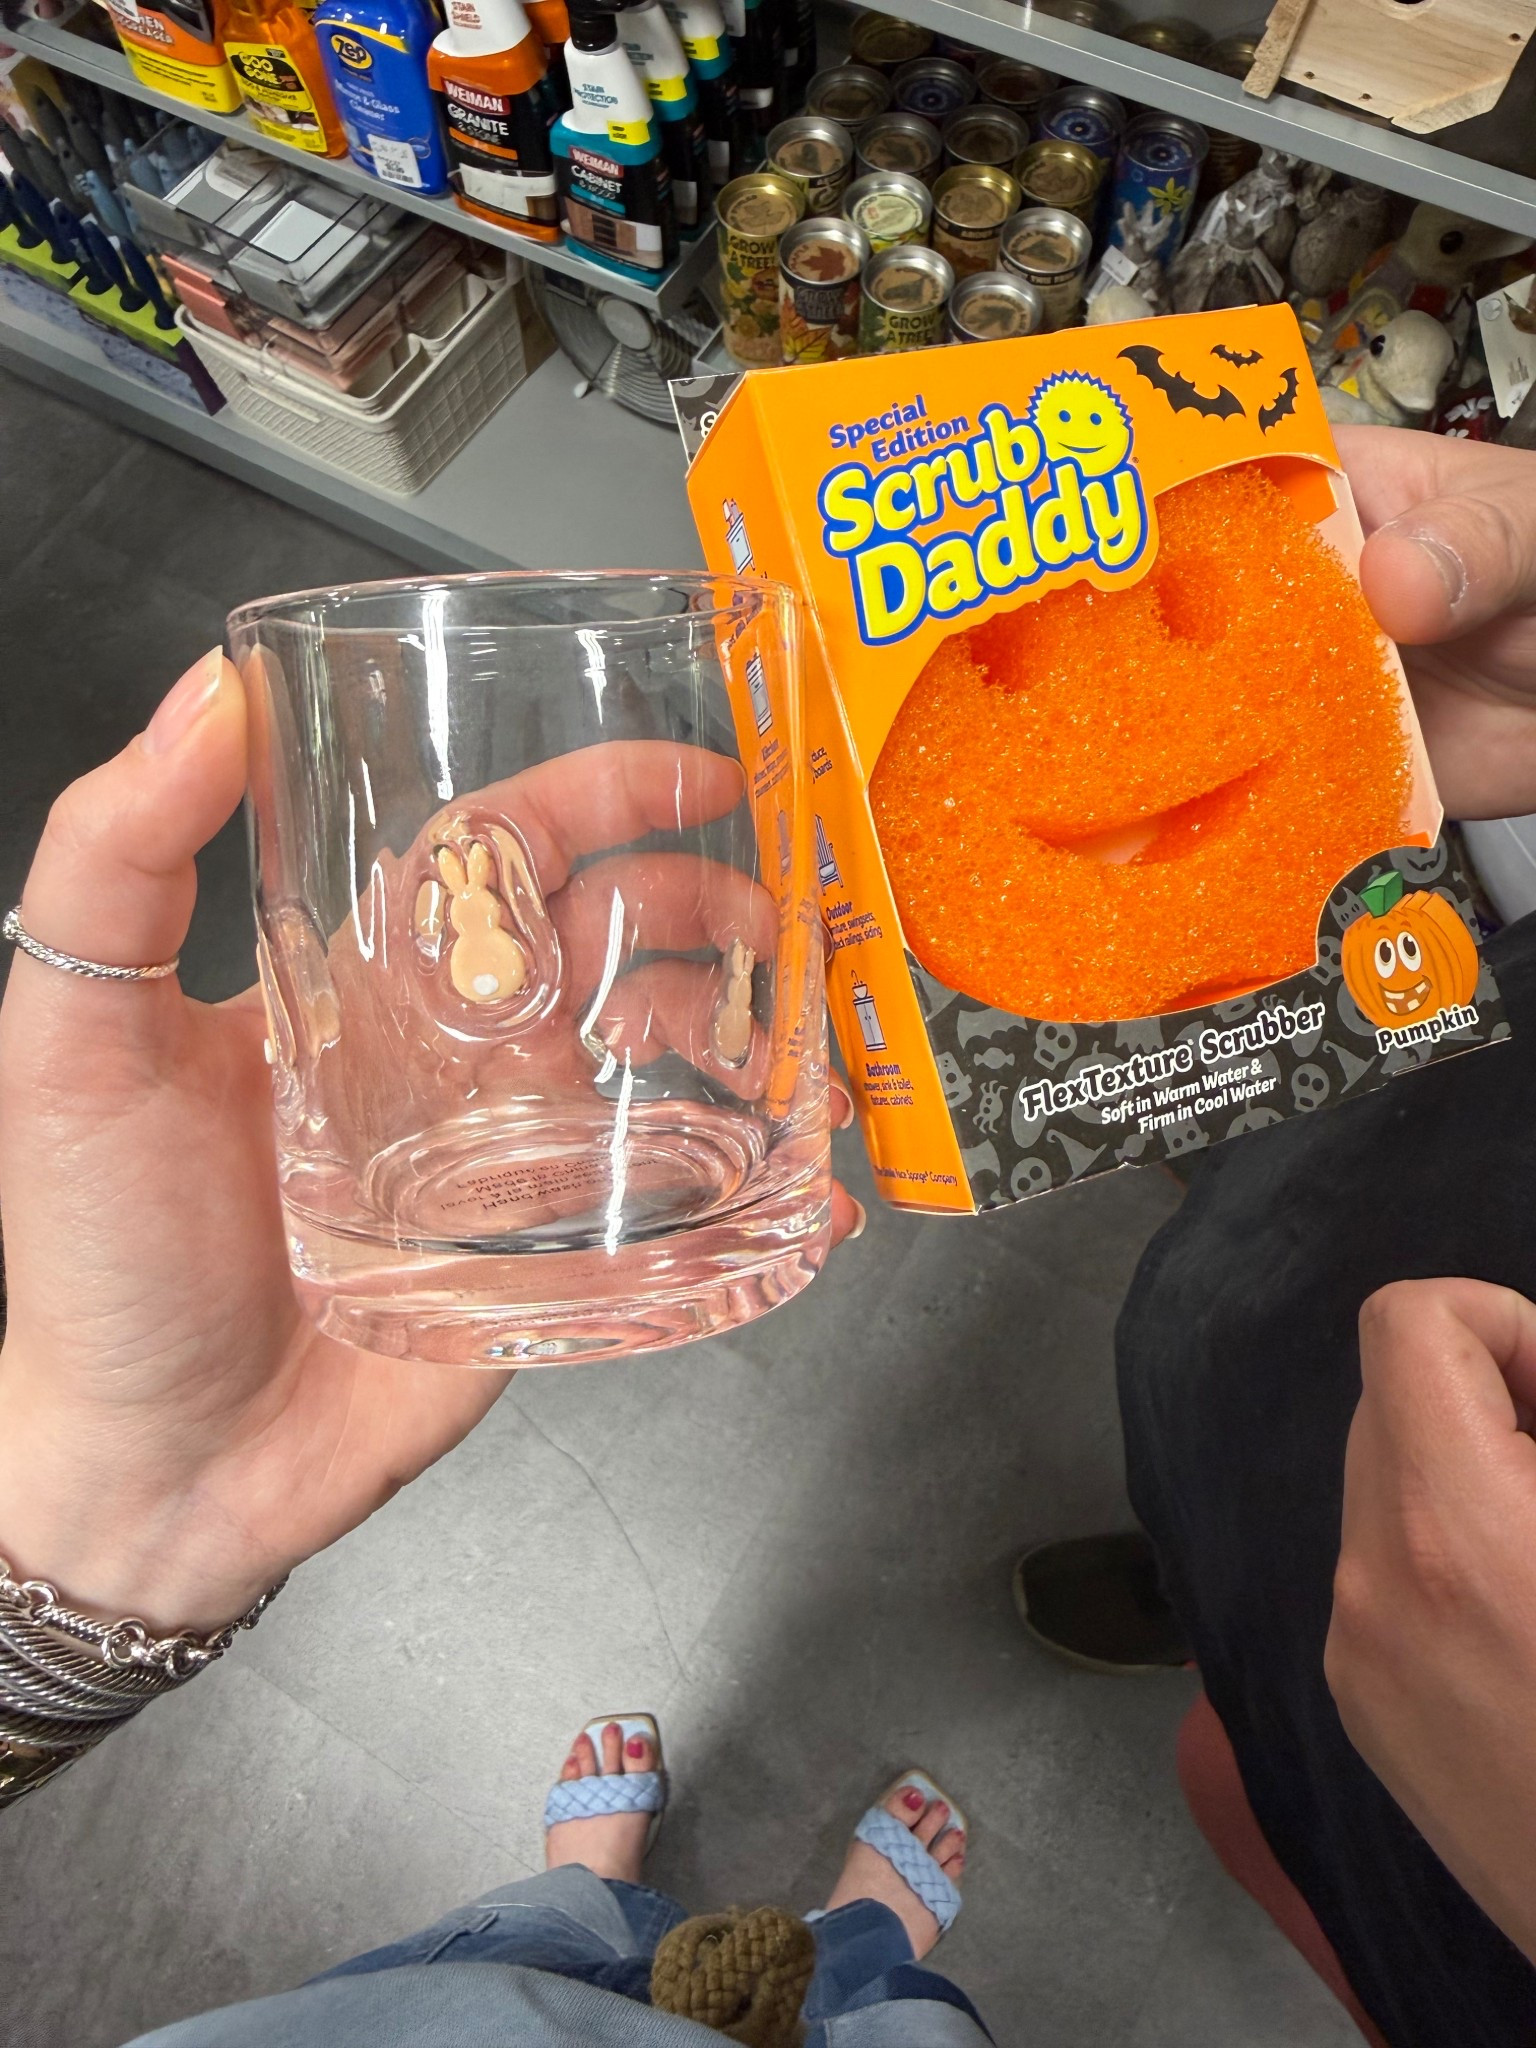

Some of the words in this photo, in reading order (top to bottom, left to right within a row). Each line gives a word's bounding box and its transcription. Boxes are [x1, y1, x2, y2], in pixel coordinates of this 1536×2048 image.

[445, 80, 504, 112] WEIMAN
[447, 103, 510, 136] GRANITE
[572, 148, 619, 176] WEIMAN
[571, 165, 622, 194] CABINET
[729, 235, 776, 254] GROW
[886, 330, 897, 343] A
[889, 314, 935, 329] GROW
[829, 394, 928, 449] Special
[871, 414, 970, 463] Edition
[822, 406, 1043, 555] Scrub
[854, 463, 1140, 641] Daddy
[826, 901, 852, 921] Outdoor
[1376, 1005, 1480, 1054] Pumpkin
[865, 1061, 902, 1078] Bathroom
[1020, 1040, 1193, 1121] FlexTexture
[1198, 1002, 1326, 1064] Scrubber
[890, 1093, 914, 1106] cabinets
[1101, 1100, 1135, 1125] Soft
[1136, 1095, 1153, 1113] in
[1154, 1079, 1202, 1109] Warm
[1202, 1065, 1250, 1092] Water
[1250, 1059, 1263, 1076] &
[1139, 1109, 1174, 1134] Firm
[1175, 1105, 1193, 1125] in
[1194, 1092, 1231, 1117] Cool
[1232, 1076, 1277, 1105] Water
[929, 1171, 958, 1187] Company
